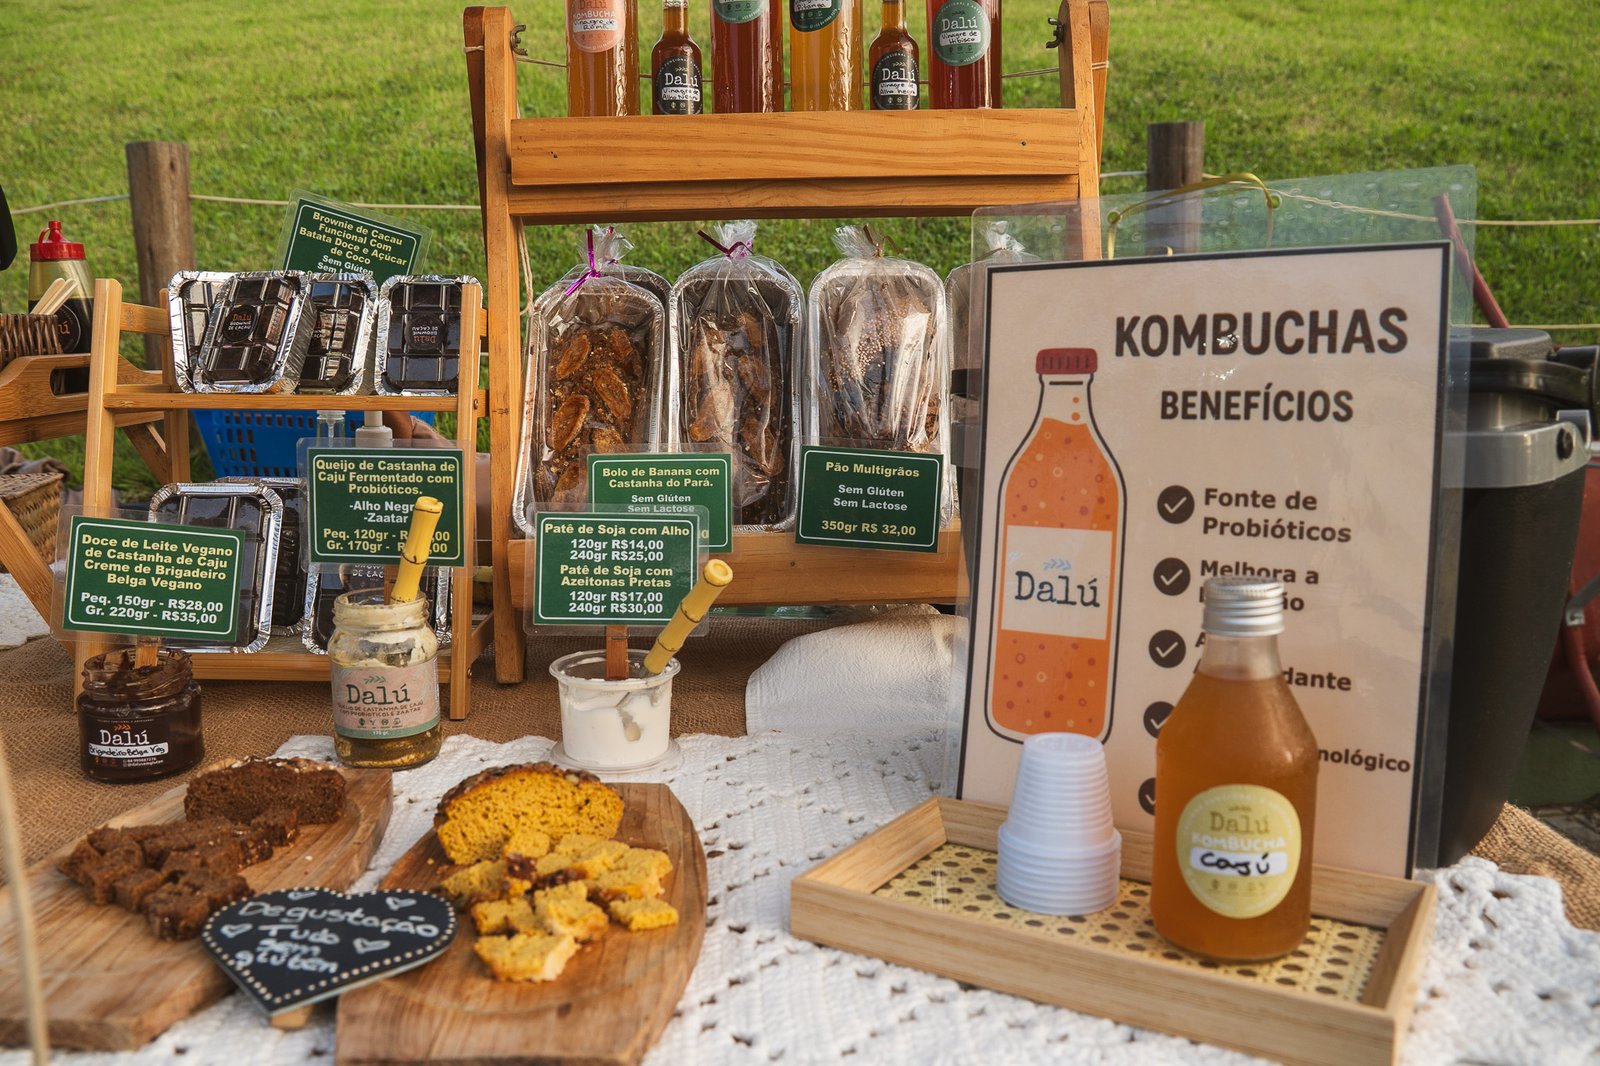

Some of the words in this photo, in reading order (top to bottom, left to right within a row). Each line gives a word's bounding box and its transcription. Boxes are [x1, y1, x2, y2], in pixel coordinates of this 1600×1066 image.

[942, 16, 978, 31] Dalú
[941, 31, 967, 40] Vinagre
[664, 72, 699, 88] Dalú
[881, 67, 916, 82] Dalú
[313, 212, 354, 230] Brownie
[356, 226, 368, 235] de
[371, 230, 403, 245] Cacau
[319, 224, 366, 244] Funcional
[370, 238, 392, 252] Com
[300, 227, 332, 243] Batata
[335, 238, 360, 252] Doce
[371, 250, 407, 266] Açúcar
[330, 247, 343, 256] de
[346, 251, 371, 265] Coco
[317, 262, 336, 273] Sem
[322, 255, 342, 266] Sem
[344, 261, 374, 276] Glúten
[1115, 307, 1408, 357] KOMBUCHAS
[1160, 382, 1354, 422] BENEFÍCIOS
[316, 460, 355, 472] Queijo
[358, 460, 374, 470] de
[378, 460, 436, 471] Castanha
[440, 461, 455, 471] de
[602, 468, 628, 476] Bolo
[632, 468, 645, 476] de
[649, 468, 691, 476] Banana
[695, 468, 720, 476] com
[826, 462, 849, 472] Pão
[854, 464, 920, 478] Multigrãos
[318, 472, 345, 484] Caju
[349, 472, 423, 482] Fermentado
[427, 474, 454, 483] com
[609, 479, 663, 488] Castanha
[666, 478, 680, 487] do
[684, 478, 714, 487] Pará.
[348, 484, 423, 495] Probióticos.
[838, 485, 863, 495] Sem
[867, 486, 904, 497] Glúten
[657, 494, 691, 502] Glúten
[833, 498, 858, 508] Sem
[862, 500, 908, 511] Lactose
[1204, 488, 1277, 509] Fonte
[1284, 490, 1318, 511] de
[350, 501, 381, 511] -Alho
[384, 501, 415, 513] Negr
[628, 505, 650, 513] Sem
[654, 505, 695, 513] Lactose
[364, 513, 408, 523] -Zaatar
[324, 528, 350, 540] Peq.
[354, 530, 389, 541] 120gr
[545, 524, 574, 534] Patê
[578, 524, 594, 534] de
[598, 524, 626, 536] Soja
[630, 527, 657, 535] com
[661, 526, 690, 536] Alho
[822, 520, 857, 533] 350gr
[862, 523, 878, 534] R$
[882, 524, 916, 536] 32,00
[1202, 517, 1352, 542] Probióticos
[82, 534, 118, 547] Doce
[122, 538, 139, 549] de
[143, 540, 178, 552] Leite
[182, 543, 233, 557] Vegano
[326, 540, 343, 550] Gr.
[348, 541, 382, 553] 170gr
[571, 539, 608, 551] 120gr
[611, 539, 664, 551] R$14,00
[85, 547, 102, 558] de
[107, 549, 172, 564] Castanha
[176, 555, 193, 565] de
[197, 557, 228, 569] Caju
[570, 551, 608, 562] 240gr
[611, 551, 664, 562] R$25,00
[84, 559, 130, 572] Creme
[134, 562, 151, 574] de
[155, 565, 226, 581] Brigadeiro
[560, 565, 590, 574] Patê
[593, 565, 609, 574] de
[613, 565, 641, 578] Soja
[645, 568, 673, 576] com
[1200, 560, 1296, 583] Melhora
[1305, 569, 1319, 584] a
[107, 574, 146, 588] Belga
[151, 577, 202, 591] Vegano
[561, 576, 625, 587] Azeitonas
[629, 577, 672, 588] Pretas
[1014, 570, 1100, 608] Dalú
[81, 592, 111, 606] Peq.
[116, 595, 156, 608] 150gr
[168, 599, 223, 613] R$28,00
[570, 591, 607, 602] 120gr
[610, 592, 663, 603] R$17,00
[85, 605, 104, 616] Gr.
[109, 607, 150, 621] 220gr
[162, 610, 217, 624] R$35,00
[569, 602, 606, 614] 240gr
[610, 603, 663, 615] R$30,00
[346, 684, 410, 705] Dalú
[396, 706, 421, 715] ZAATAR
[100, 729, 150, 745] Dalú
[1210, 812, 1270, 834] Dalú
[1192, 834, 1286, 851] KOMBUCHA
[238, 901, 439, 937] Degustação
[258, 924, 340, 945] Tudo
